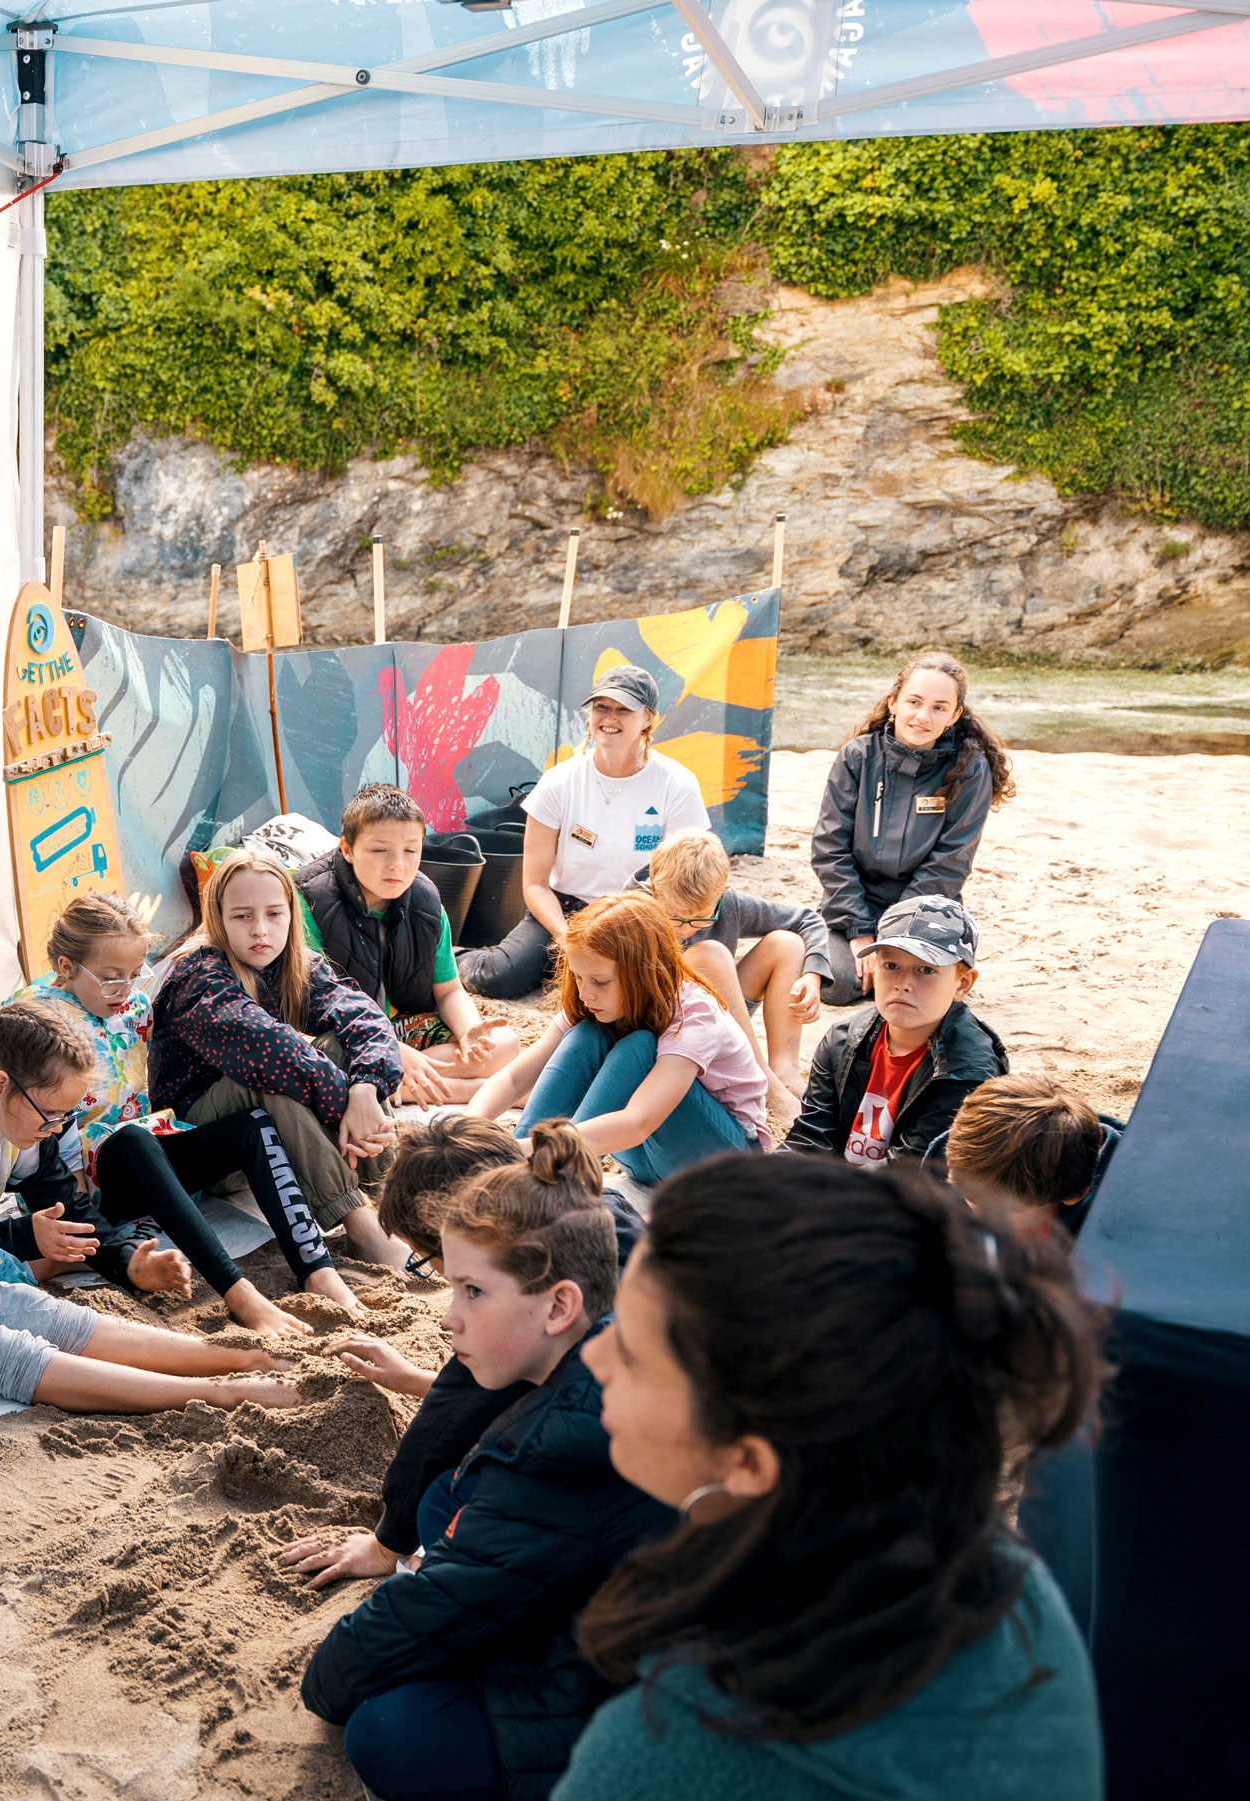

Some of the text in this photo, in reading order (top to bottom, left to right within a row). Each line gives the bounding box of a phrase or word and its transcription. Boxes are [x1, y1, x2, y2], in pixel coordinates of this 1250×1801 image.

[17, 650, 74, 685] GET THE
[2, 686, 98, 757] FACTS
[635, 835, 663, 844] OCEAN
